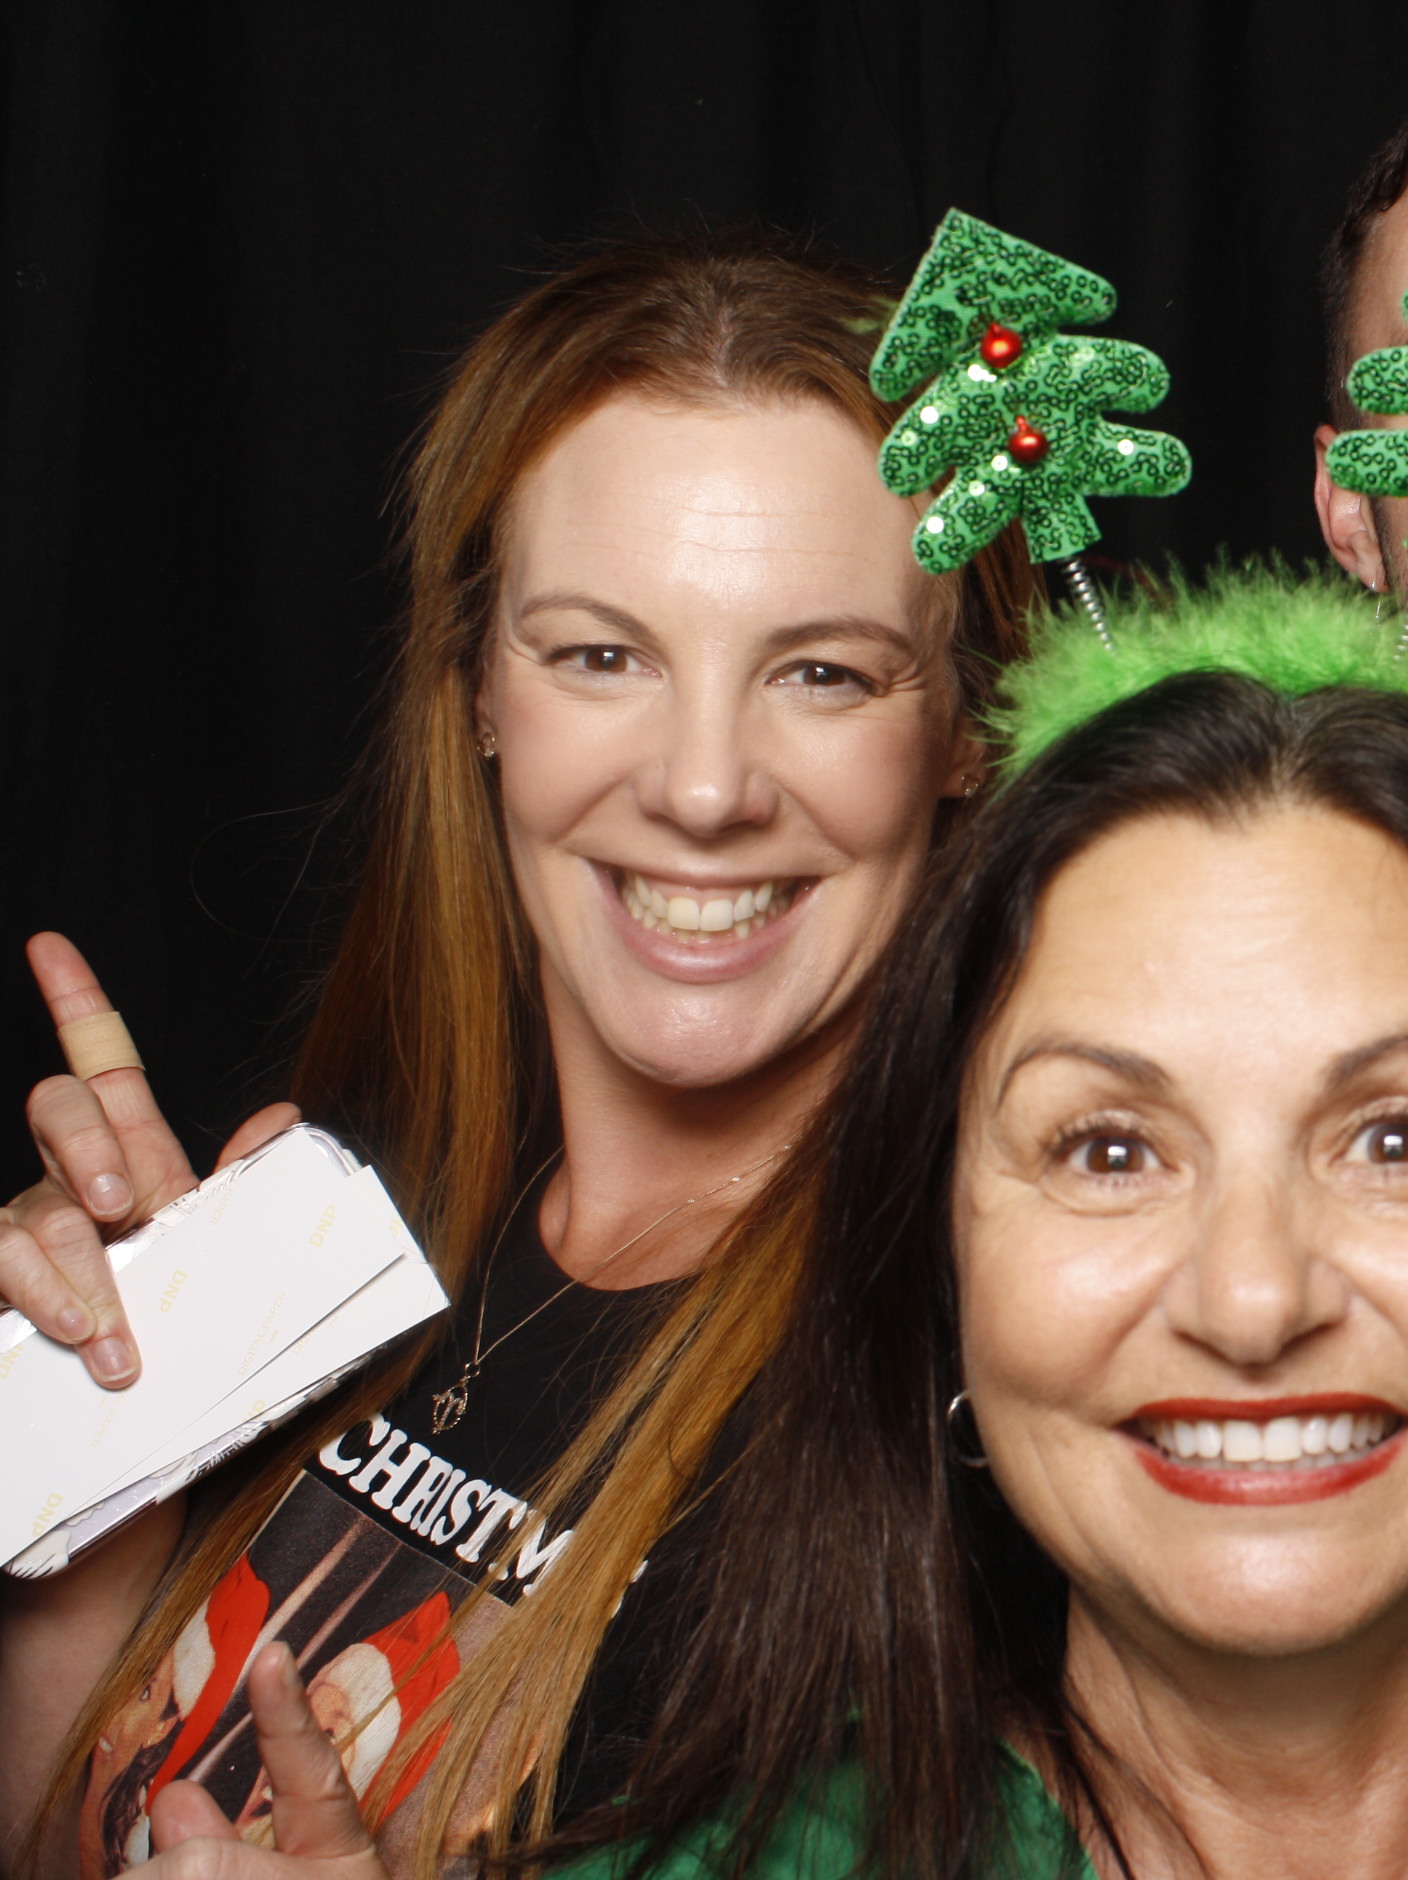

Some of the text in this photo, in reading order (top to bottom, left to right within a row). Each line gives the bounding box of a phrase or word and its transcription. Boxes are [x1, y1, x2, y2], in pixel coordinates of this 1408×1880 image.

[307, 1203, 338, 1249] DNP
[159, 1268, 189, 1314] DNP
[238, 1331, 265, 1375] DIGITAL
[262, 1290, 287, 1329] PAPER
[31, 1491, 64, 1539] DNP
